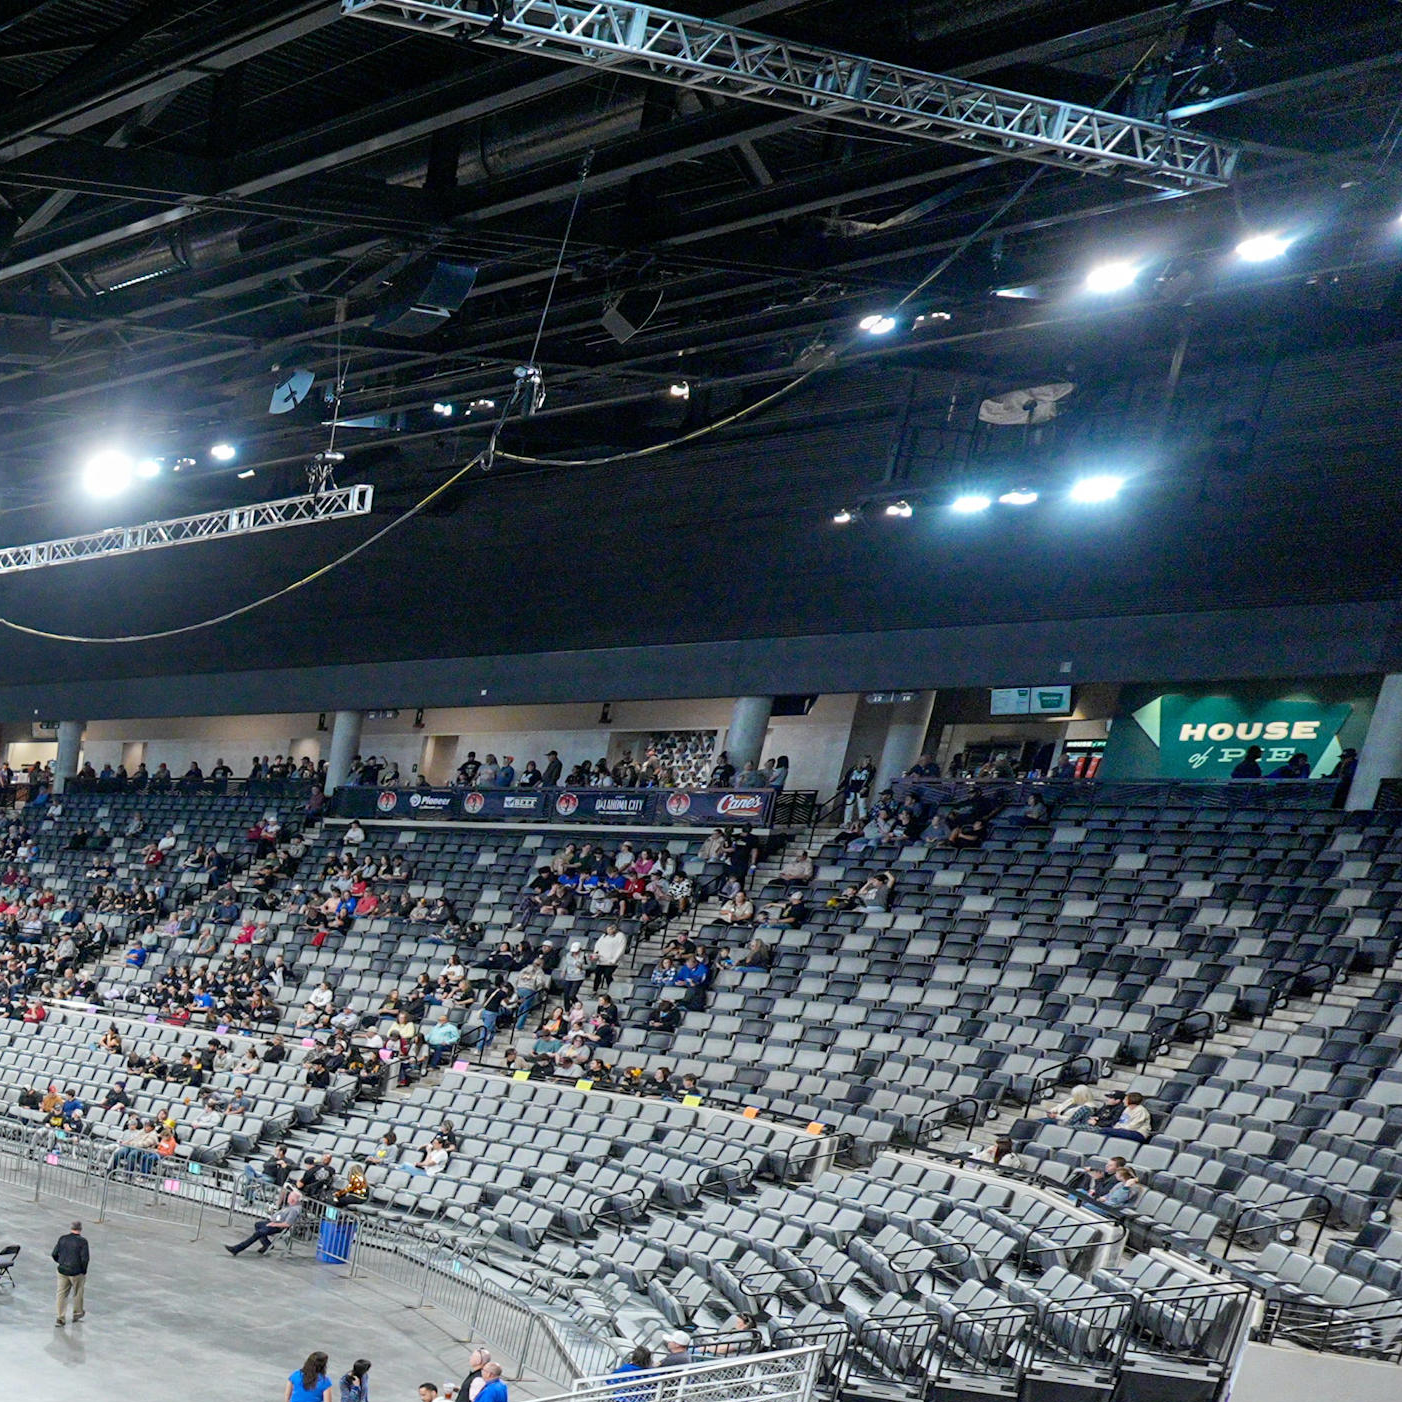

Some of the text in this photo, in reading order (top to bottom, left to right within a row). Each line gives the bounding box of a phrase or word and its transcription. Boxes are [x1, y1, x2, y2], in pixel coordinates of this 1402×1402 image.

[1178, 721, 1321, 741] HOUSE
[1188, 746, 1296, 769] of PE
[421, 796, 451, 806] Pioneer
[628, 799, 644, 811] CITY
[717, 794, 763, 814] Cane's
